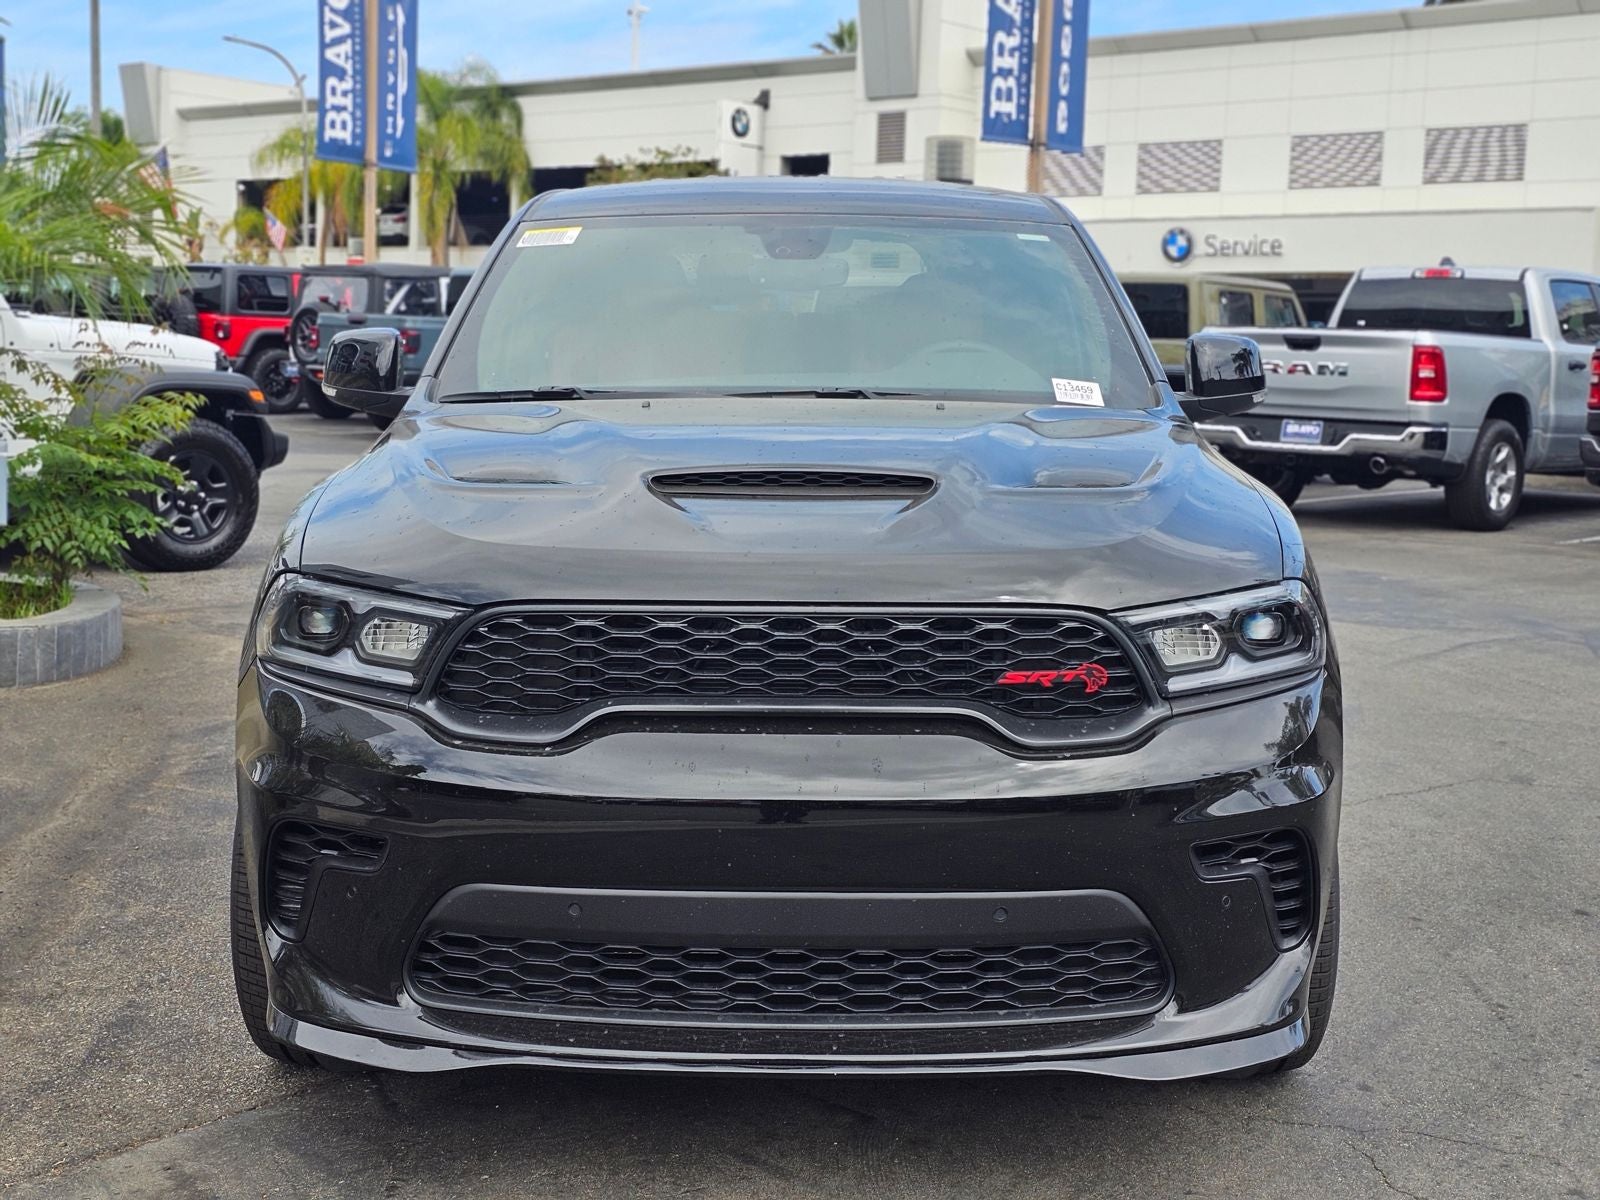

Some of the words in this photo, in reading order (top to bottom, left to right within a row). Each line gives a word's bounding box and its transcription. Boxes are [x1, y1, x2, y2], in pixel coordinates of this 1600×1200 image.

[989, 0, 1024, 121] BRA
[1203, 233, 1284, 258] Service
[1263, 359, 1349, 378] RAM
[997, 670, 1087, 688] SRT
